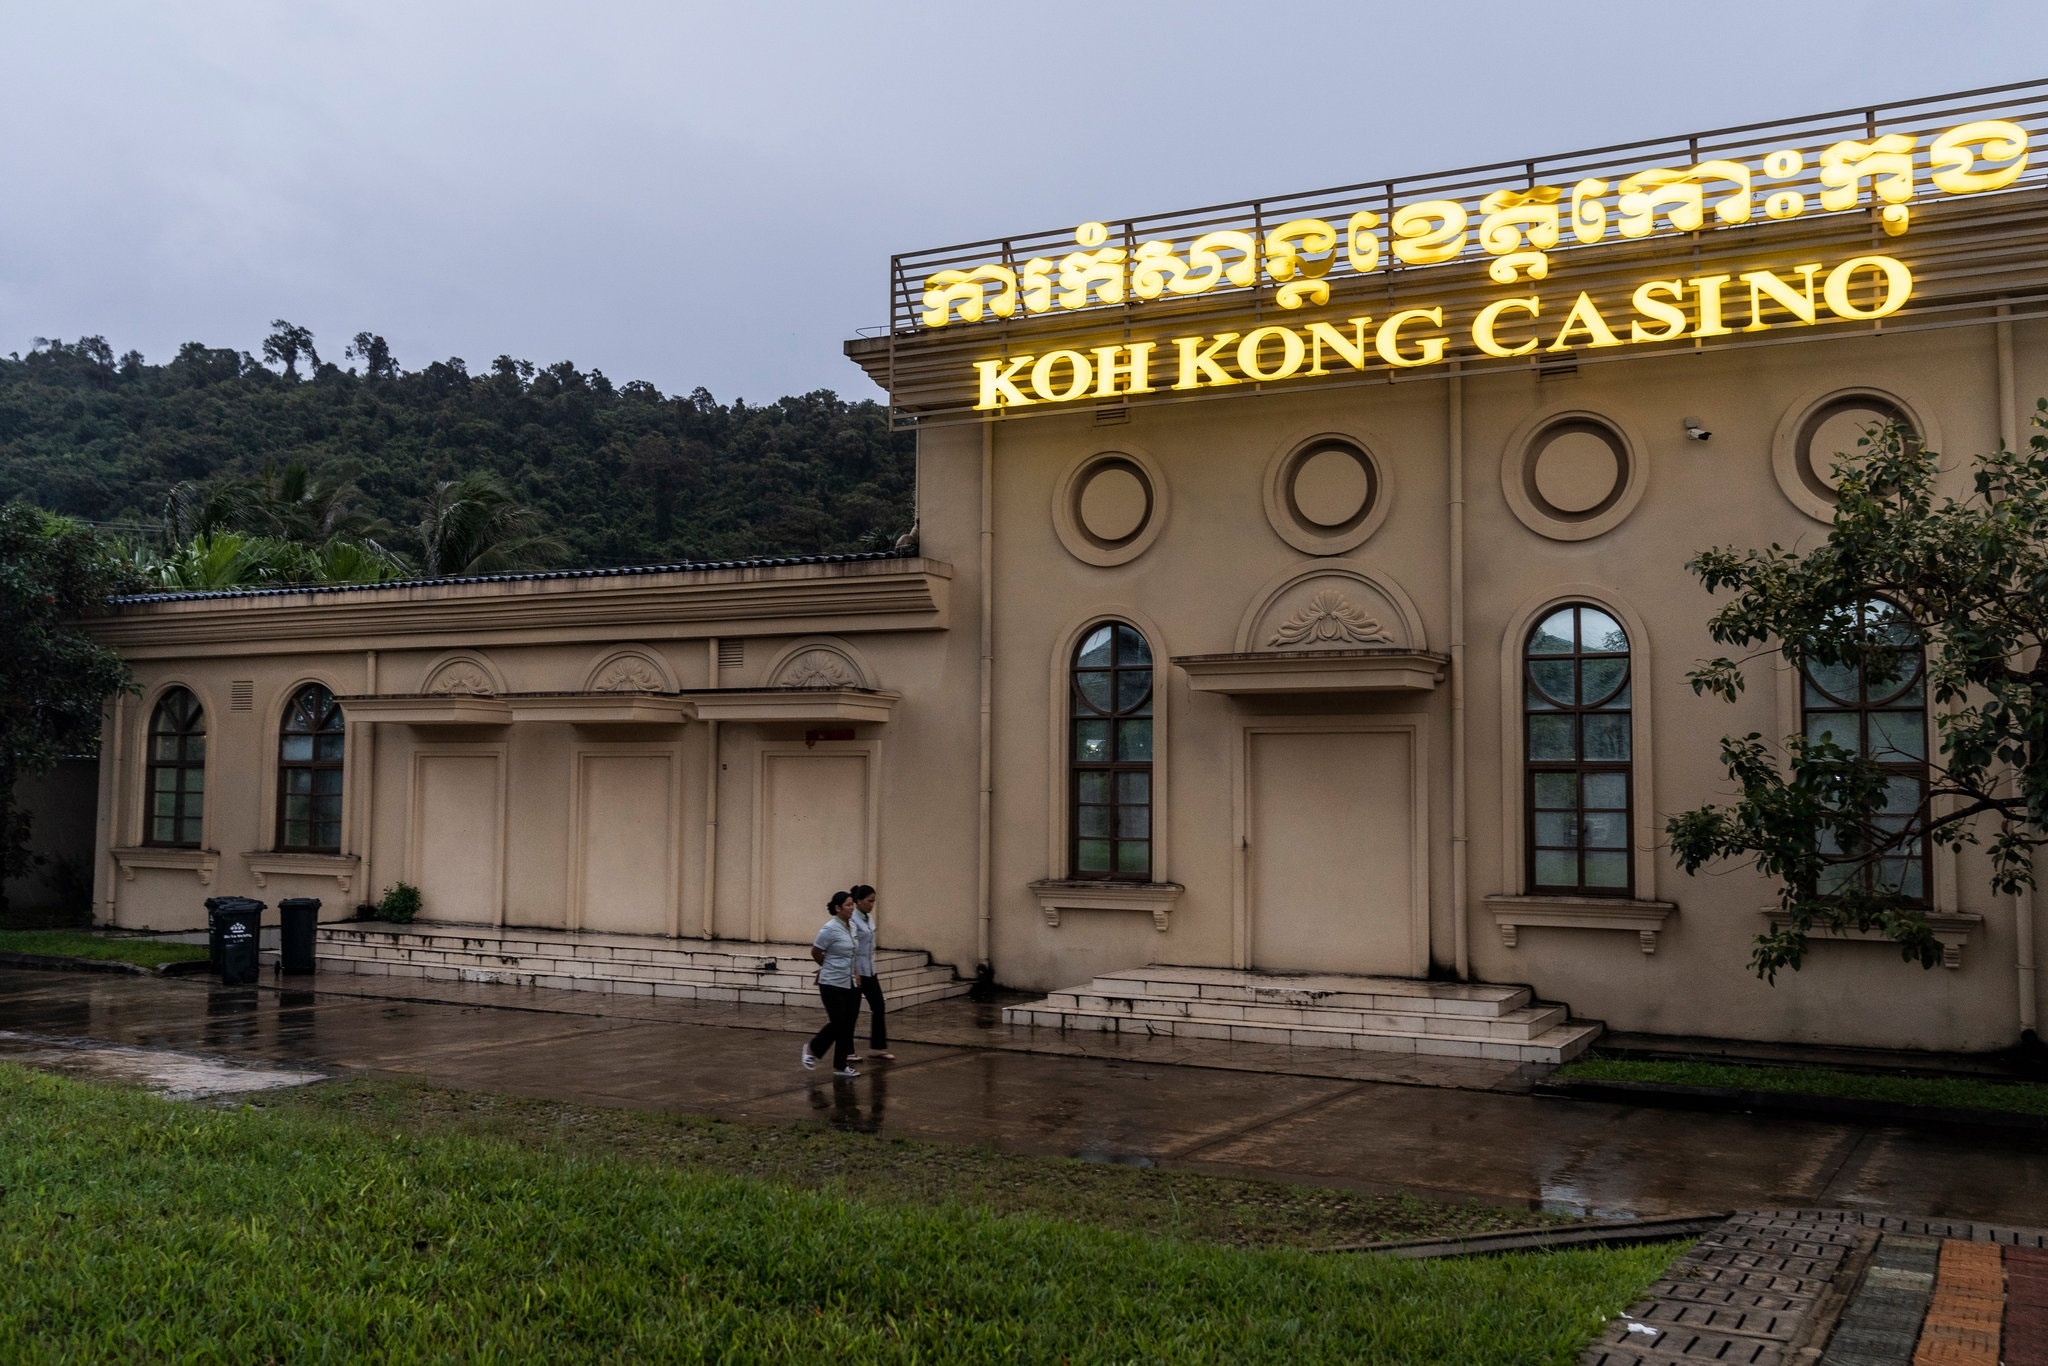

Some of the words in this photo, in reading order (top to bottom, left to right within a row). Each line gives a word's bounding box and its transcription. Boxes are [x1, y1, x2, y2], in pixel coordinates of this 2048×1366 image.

[972, 340, 1157, 412] KOH
[1171, 304, 1450, 393] KONG
[1470, 254, 1916, 360] CASINO
